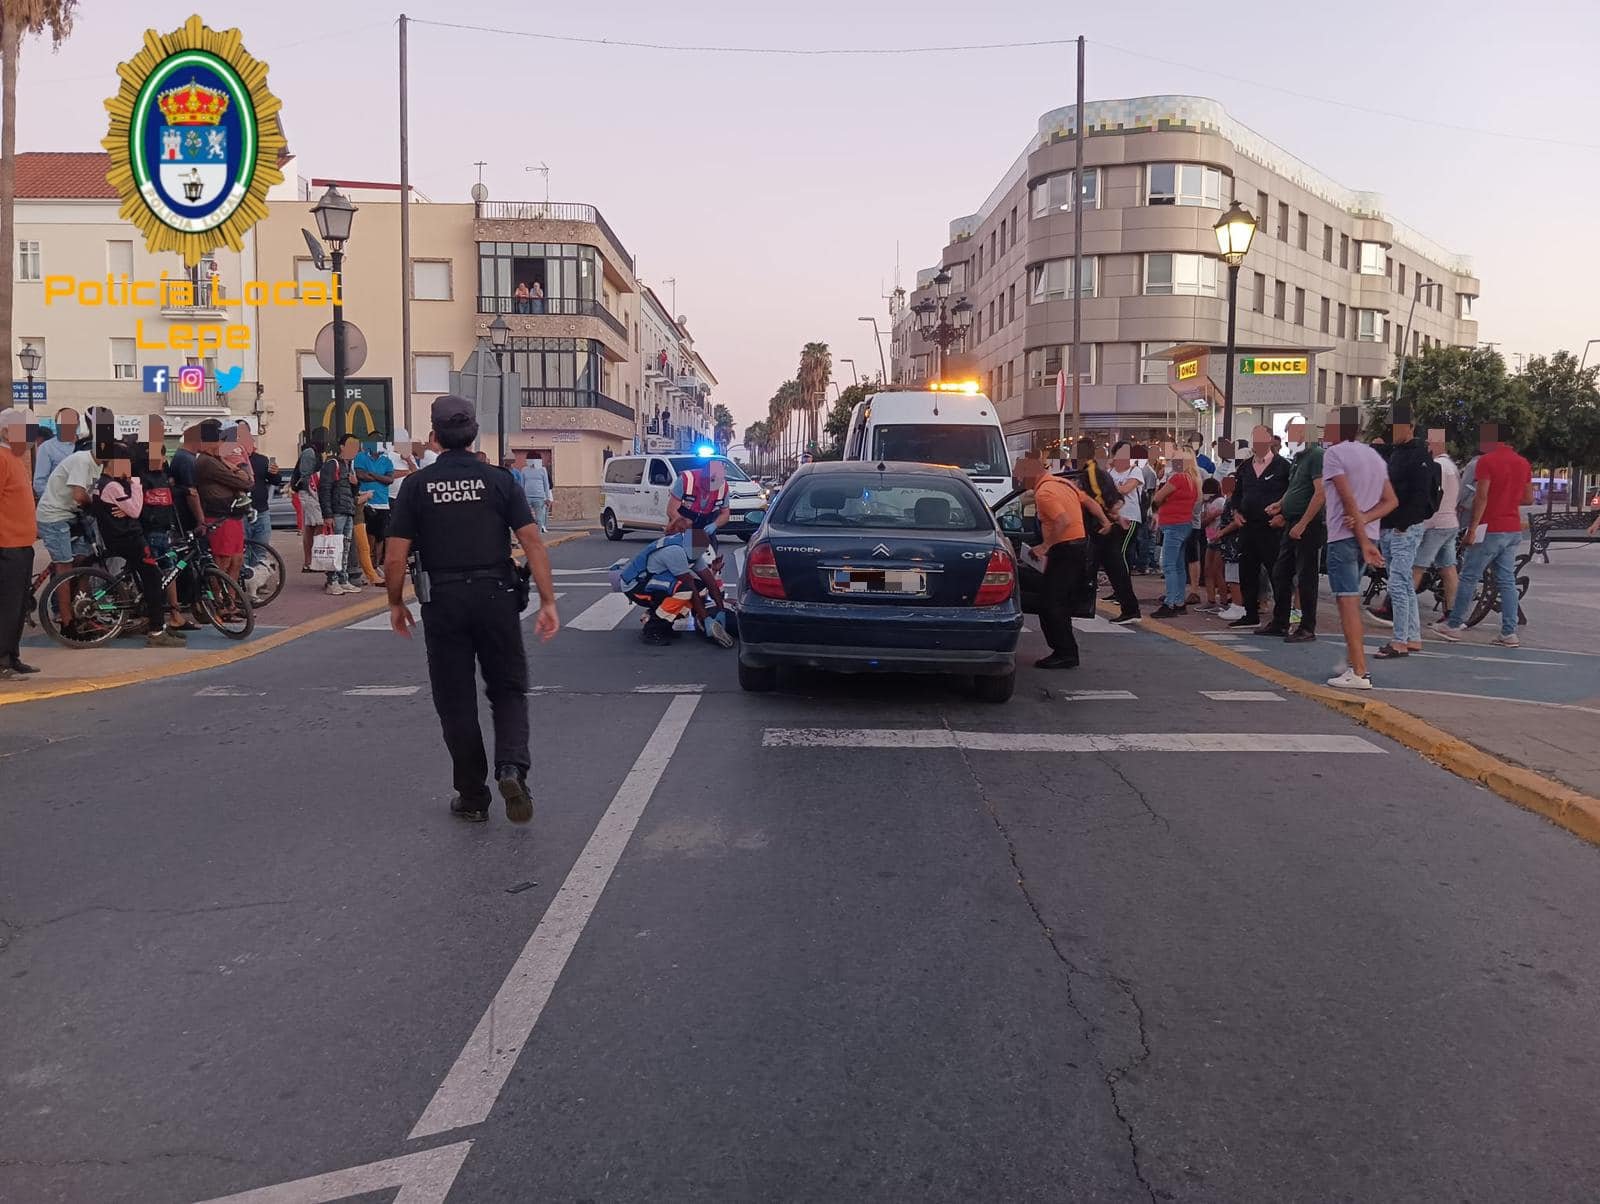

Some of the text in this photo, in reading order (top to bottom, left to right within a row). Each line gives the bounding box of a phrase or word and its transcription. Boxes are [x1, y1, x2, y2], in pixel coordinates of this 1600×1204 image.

[1181, 363, 1197, 376] ONCE
[1260, 361, 1302, 371] ONCE
[331, 388, 362, 399] LPE
[426, 479, 486, 493] POLICIA
[433, 490, 481, 503] LOCAL
[961, 551, 986, 559] C5
